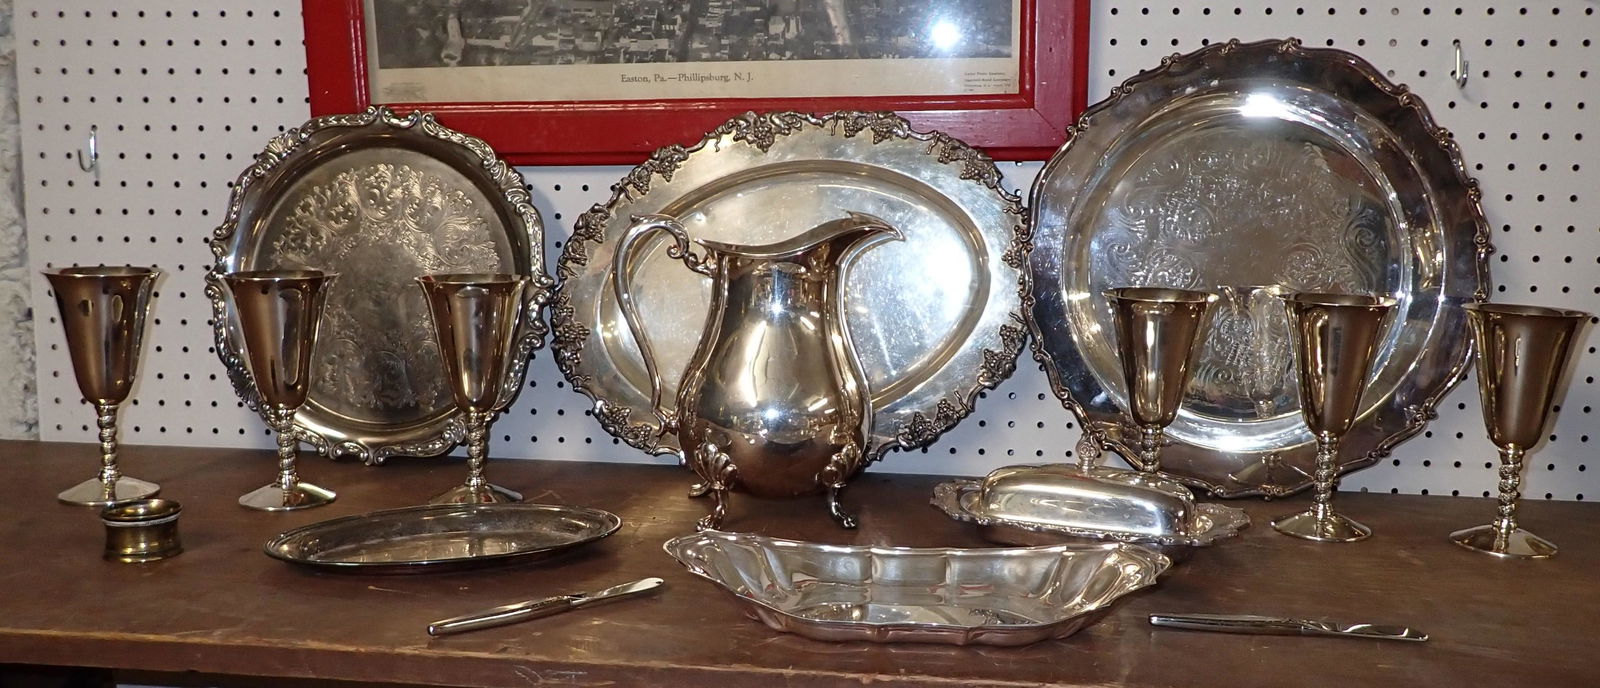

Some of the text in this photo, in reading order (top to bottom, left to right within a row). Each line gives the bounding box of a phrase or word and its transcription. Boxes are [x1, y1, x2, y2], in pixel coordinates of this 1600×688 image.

[620, 74, 651, 83] Easton,
[734, 72, 745, 81] N.
[747, 72, 754, 82] J.
